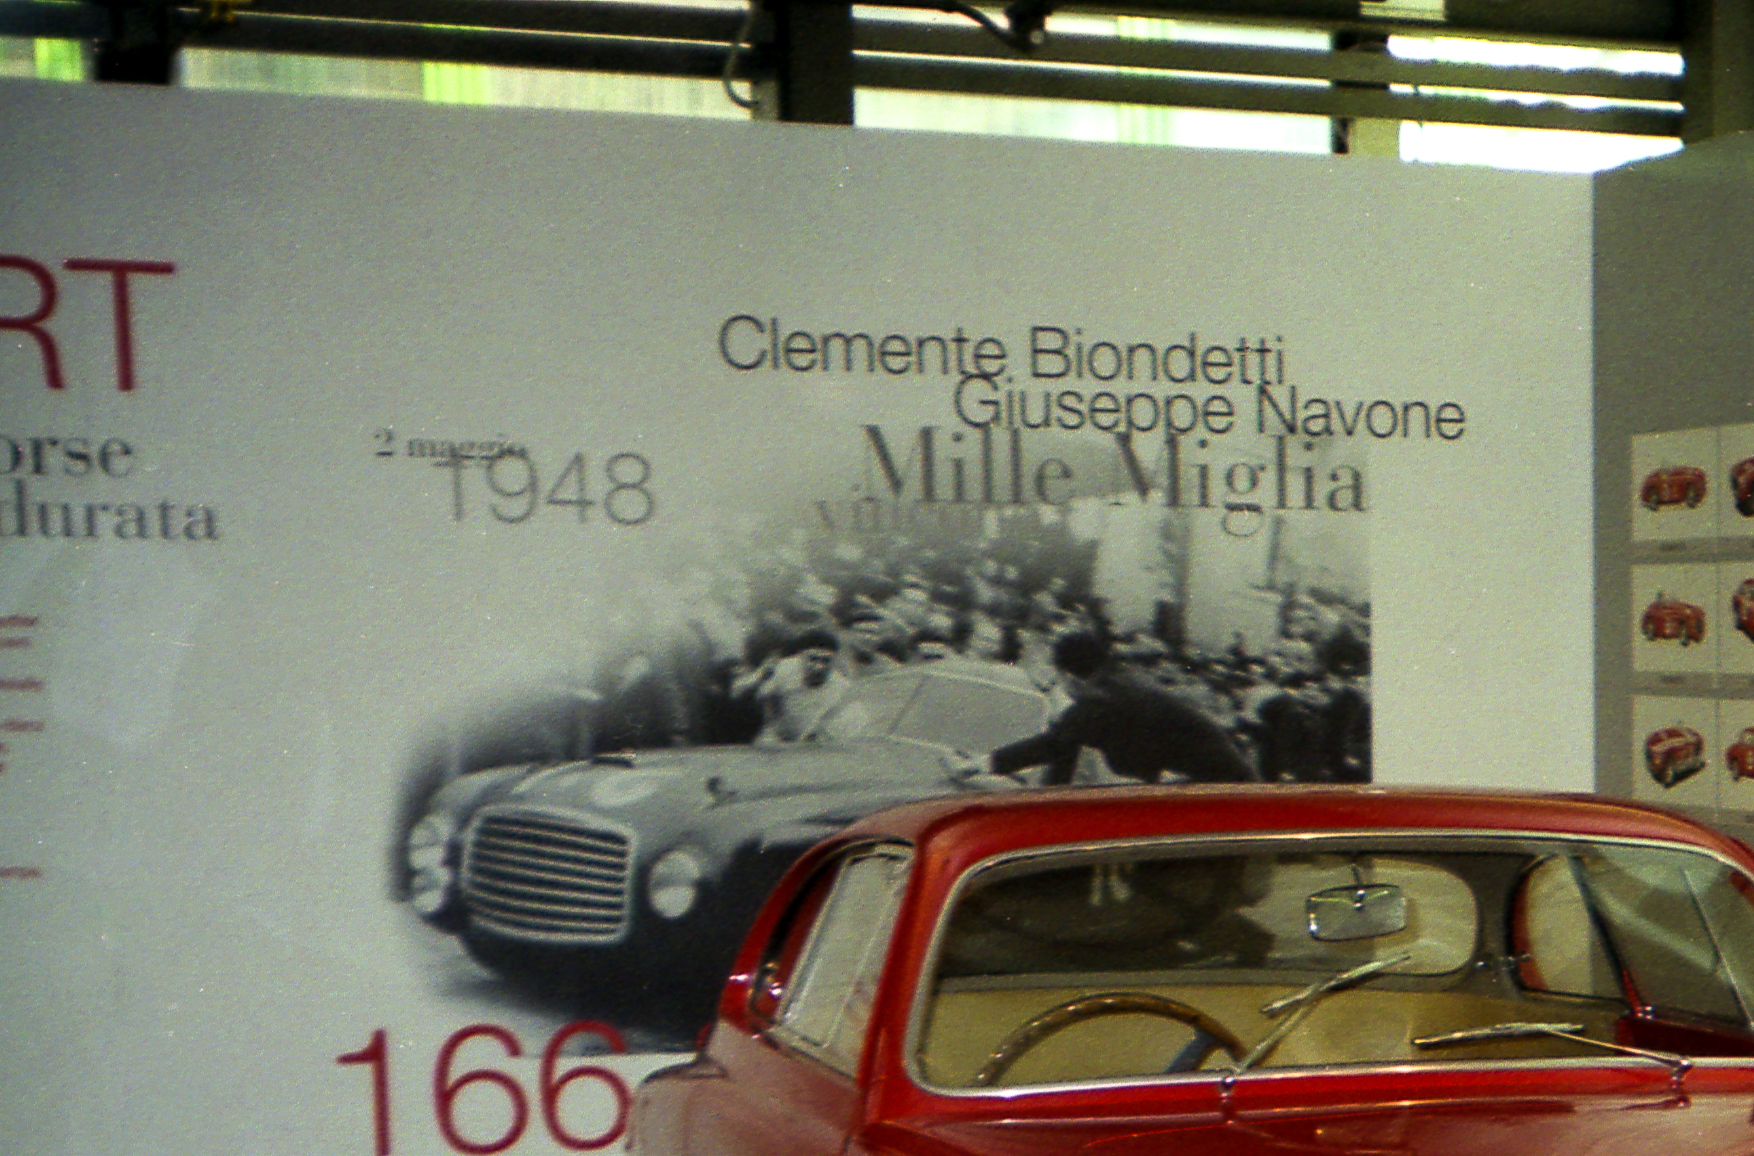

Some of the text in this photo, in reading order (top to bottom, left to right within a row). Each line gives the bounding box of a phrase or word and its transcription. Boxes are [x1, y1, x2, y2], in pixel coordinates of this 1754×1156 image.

[718, 314, 1286, 387] Clemente Biondetti
[373, 427, 395, 456] 2
[954, 375, 1467, 441] Giuseppe Navone
[432, 451, 655, 524] 1948
[865, 424, 1368, 537] Mille Miglia
